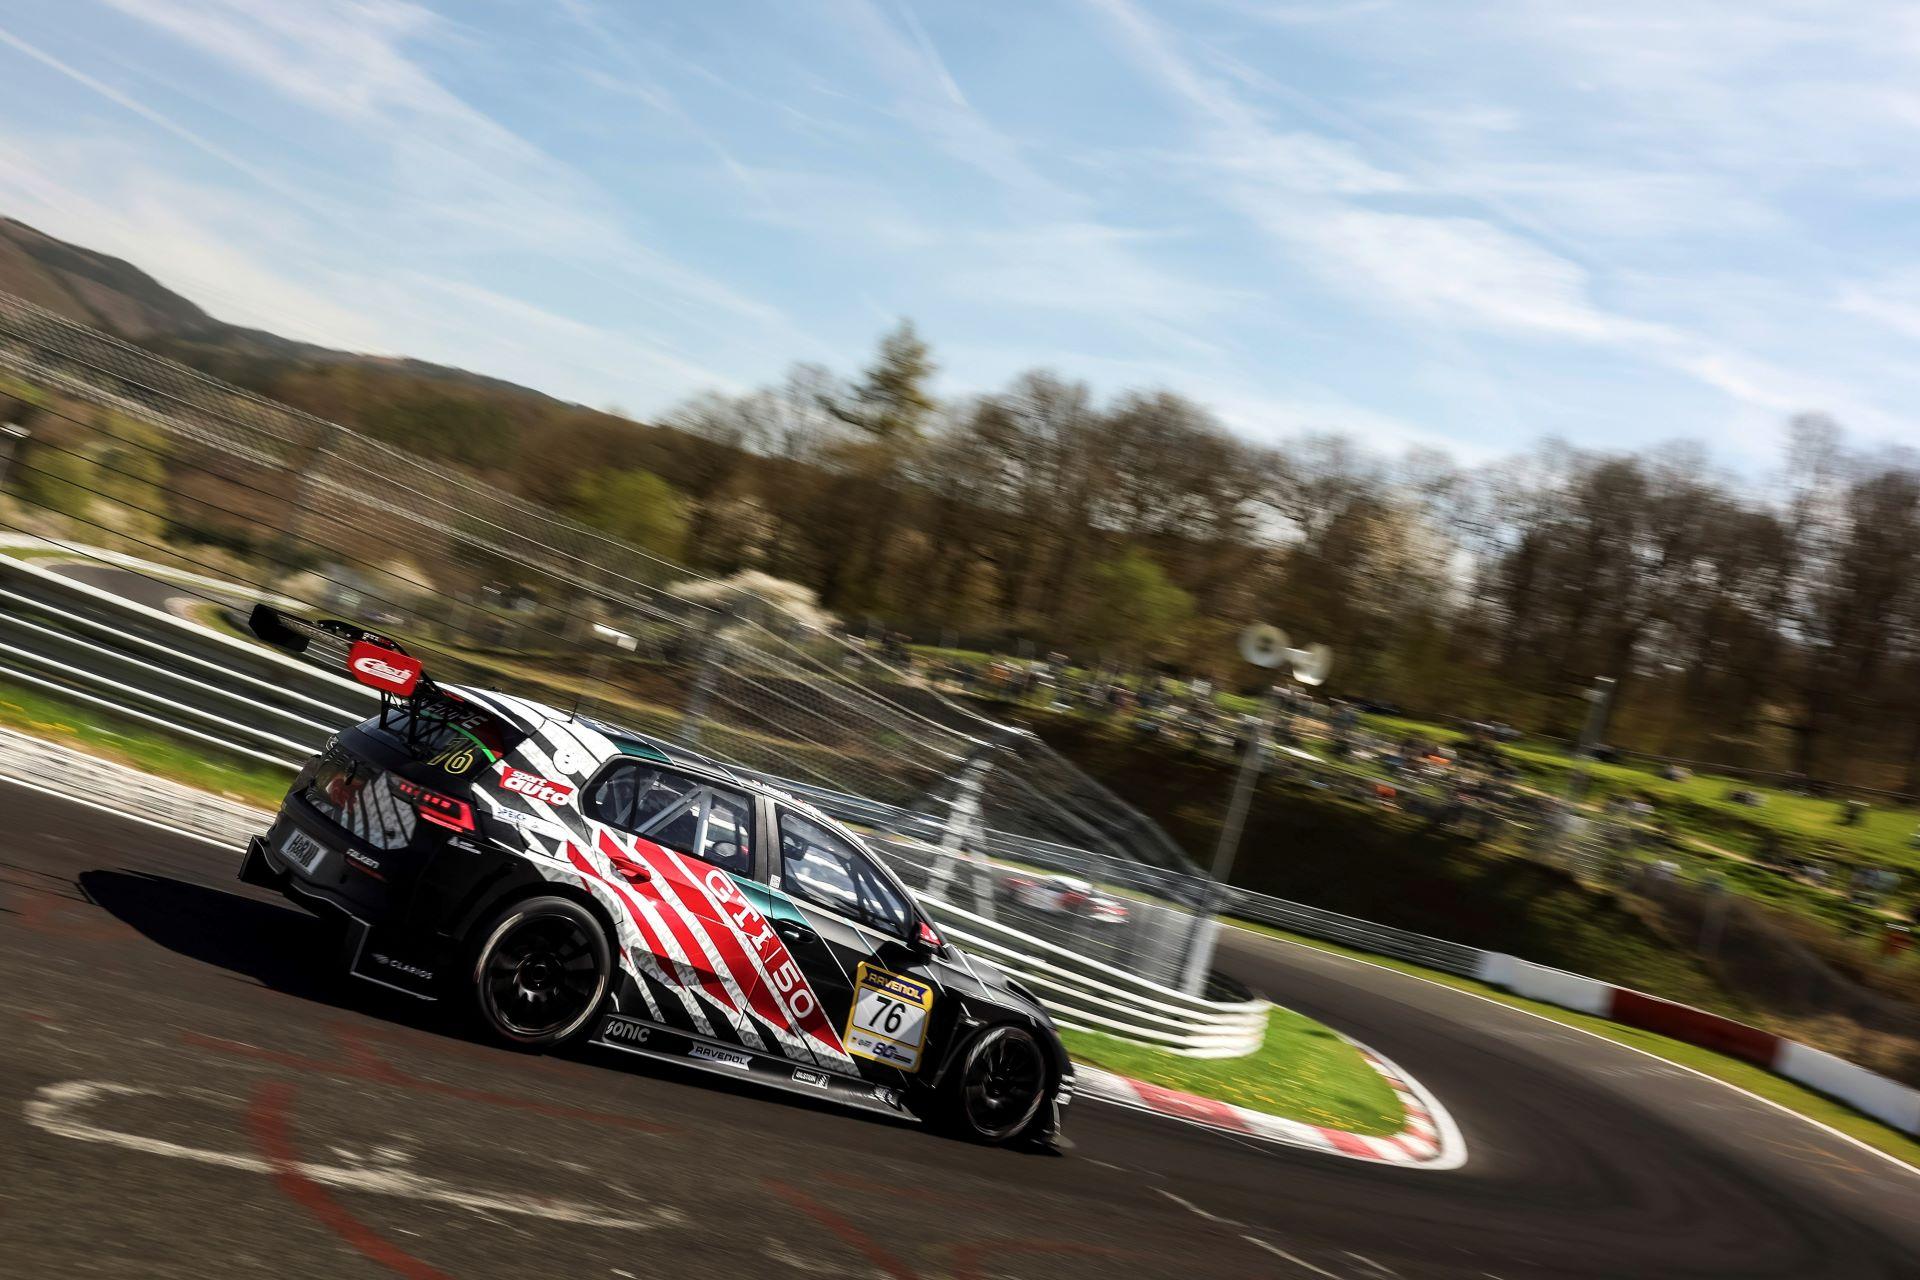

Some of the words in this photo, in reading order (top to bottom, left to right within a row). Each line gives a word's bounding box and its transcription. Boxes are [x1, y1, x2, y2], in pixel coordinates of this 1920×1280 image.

[504, 777, 570, 806] auto
[705, 869, 776, 952] GTI
[772, 959, 815, 1019] 50
[868, 972, 922, 1000] RAVENOL
[868, 995, 906, 1034] 76
[695, 1046, 746, 1066] RAVENOL
